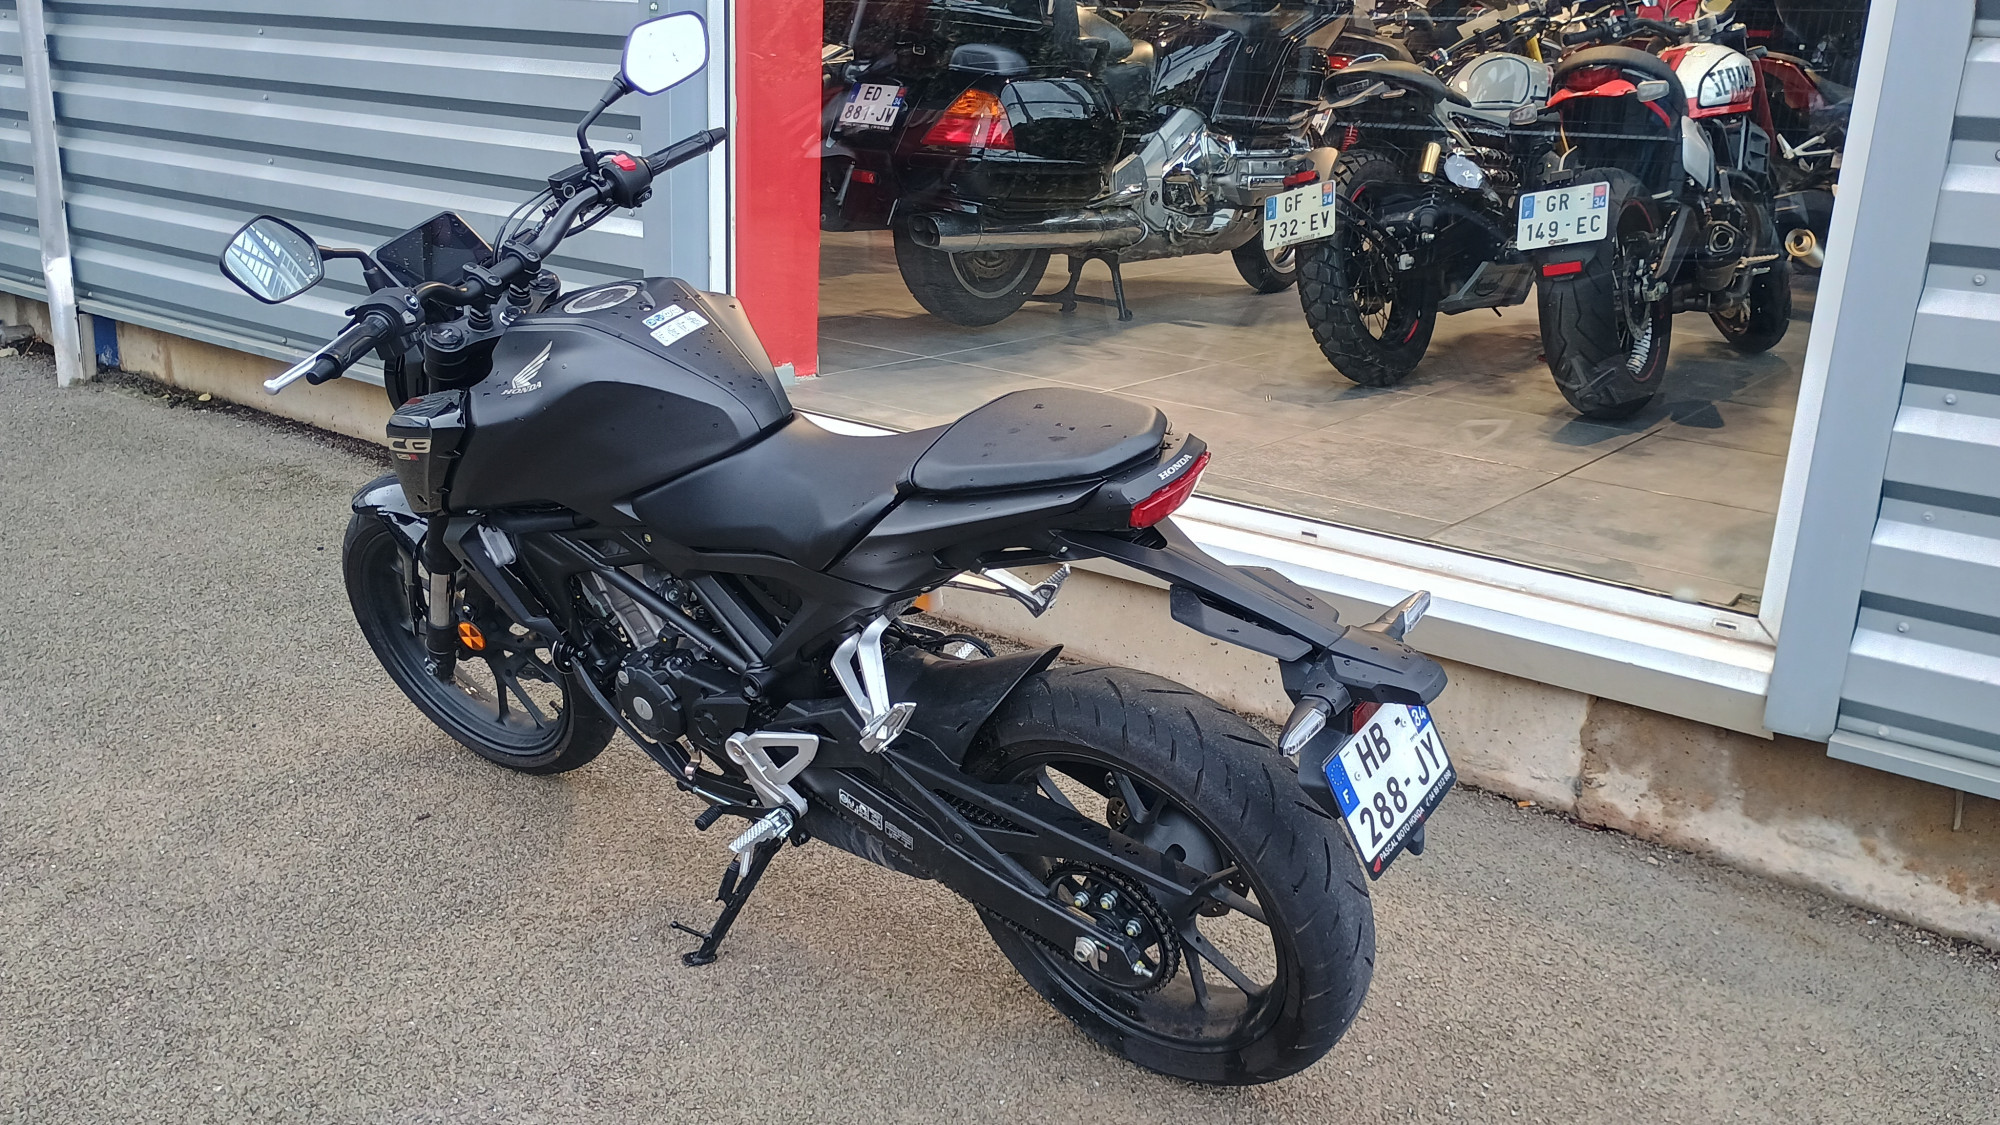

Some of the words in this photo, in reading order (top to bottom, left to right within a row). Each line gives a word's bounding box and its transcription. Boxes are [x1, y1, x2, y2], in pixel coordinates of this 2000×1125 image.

[864, 86, 882, 101] ED
[1285, 193, 1303, 213] GF
[1322, 195, 1332, 205] 34
[1546, 193, 1570, 212] GR
[1593, 196, 1605, 207] 34
[1269, 210, 1330, 242] 732-EV
[501, 380, 542, 395] HONDA
[1158, 454, 1193, 480] HONDA
[1411, 705, 1427, 727] 34
[1355, 722, 1391, 778] HB
[1342, 788, 1350, 804] F
[1360, 731, 1440, 848] 288-JY
[1380, 838, 1399, 861] PASCAL
[1396, 822, 1411, 842] MOTO
[1408, 806, 1425, 831] HONDA
